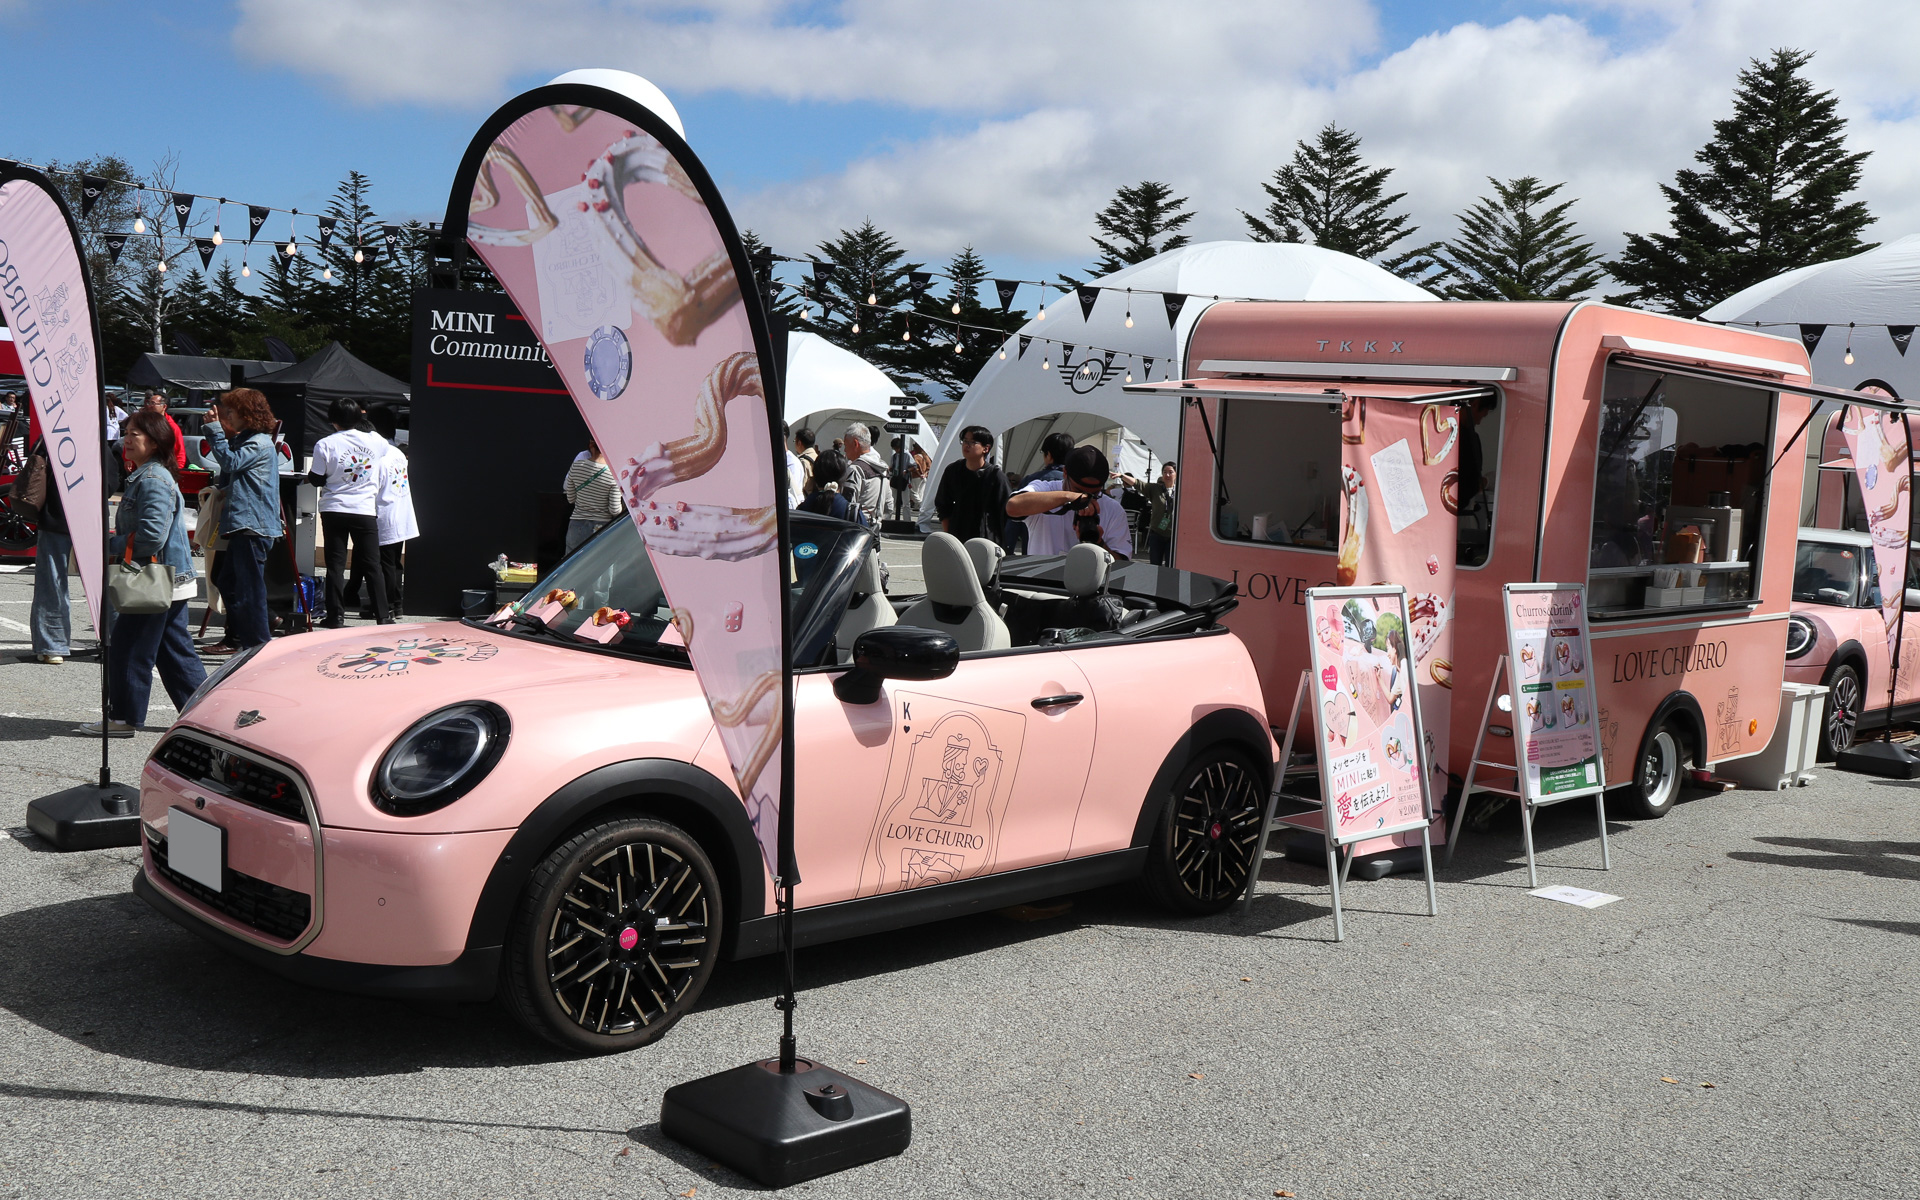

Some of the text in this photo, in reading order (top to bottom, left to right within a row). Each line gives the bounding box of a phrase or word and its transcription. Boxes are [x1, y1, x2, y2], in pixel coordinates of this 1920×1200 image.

[430, 309, 496, 335] MINI
[430, 334, 555, 369] Communit
[1075, 371, 1100, 381] MINI
[338, 449, 352, 466] MINI
[1232, 569, 1307, 606] LOVE
[1613, 641, 1727, 683] LOVE CHURRO
[902, 701, 912, 721] K
[1332, 752, 1367, 774] メッセージを
[886, 822, 984, 850] LOVE CHURRO
[622, 934, 636, 944] MINI
